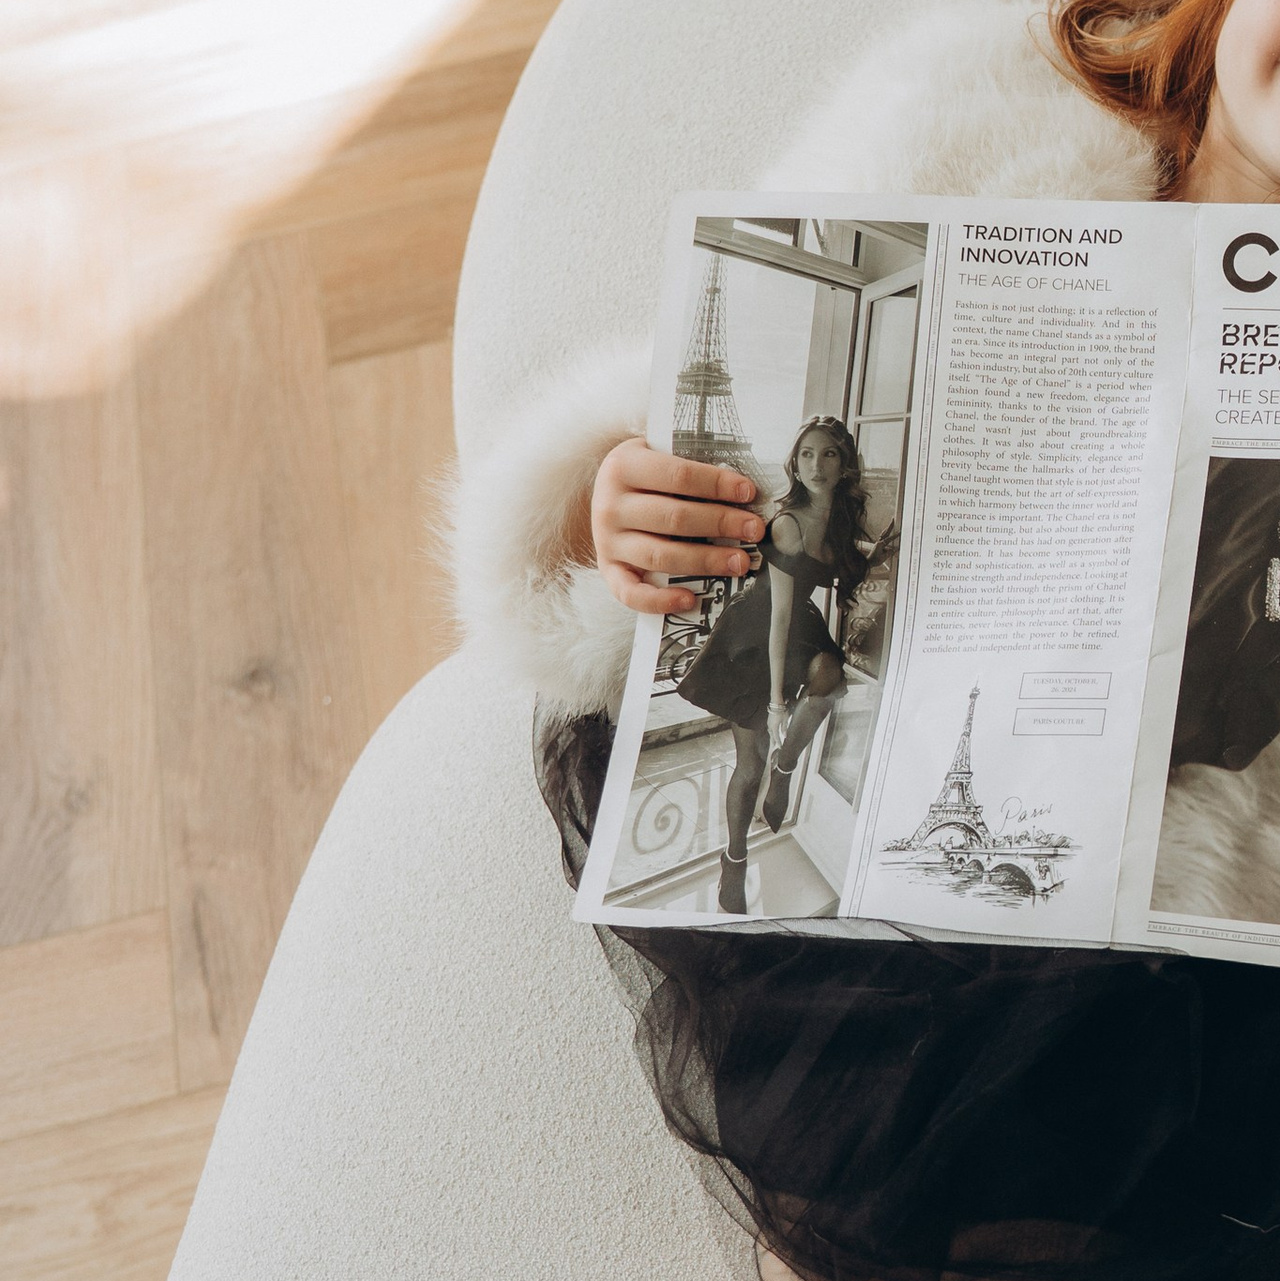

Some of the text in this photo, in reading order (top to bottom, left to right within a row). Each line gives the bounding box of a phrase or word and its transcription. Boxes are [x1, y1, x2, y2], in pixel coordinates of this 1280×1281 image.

[963, 224, 1122, 243] TRADITION AND
[960, 247, 1088, 266] INNOVATION
[958, 273, 1111, 291] THE AGE OF CHANEL
[955, 300, 988, 309] Fashion
[991, 302, 998, 310] is
[1018, 304, 1034, 313] just
[1037, 304, 1075, 316] clothing;
[1106, 306, 1145, 316] reflection
[1148, 308, 1158, 316] of
[954, 312, 1156, 328] time, culture and individuality. And in this
[952, 326, 986, 334] context,
[989, 326, 1003, 334] the
[1031, 329, 1062, 338] Chanel
[1065, 331, 1092, 339] stands
[1113, 332, 1144, 342] symbol
[1147, 333, 1157, 341] of
[951, 338, 962, 347] an
[983, 338, 1006, 347] Since
[1008, 339, 1018, 347] its
[1021, 340, 1074, 351] introduction
[1077, 343, 1085, 351] in
[1089, 344, 1111, 352] 1909,
[1114, 344, 1127, 353] the
[1129, 344, 1155, 353] brand
[950, 348, 965, 359] has
[970, 349, 1003, 359] become
[1024, 353, 1056, 364] integral
[1061, 357, 1078, 365] part
[1103, 356, 1122, 367] only
[1127, 357, 1137, 365] of
[1140, 357, 1154, 366] the
[949, 360, 1153, 380] fashion industry, but also of 20th century culture
[1001, 376, 1017, 387] Age
[1022, 377, 1032, 385] of
[1075, 380, 1082, 388] is
[1096, 381, 1124, 391] period
[1129, 382, 1151, 390] when
[947, 385, 978, 394] fashion
[984, 387, 1010, 397] found
[1050, 390, 1087, 401] freedom,
[1093, 393, 1129, 404] elegance
[1134, 394, 1150, 402] and
[1217, 388, 1251, 403] THE
[922, 644, 960, 653] confident
[962, 643, 978, 651] and
[980, 642, 1030, 653] independent
[1042, 641, 1055, 649] the
[1081, 641, 1102, 651] time.
[995, 796, 1052, 834] Paris
